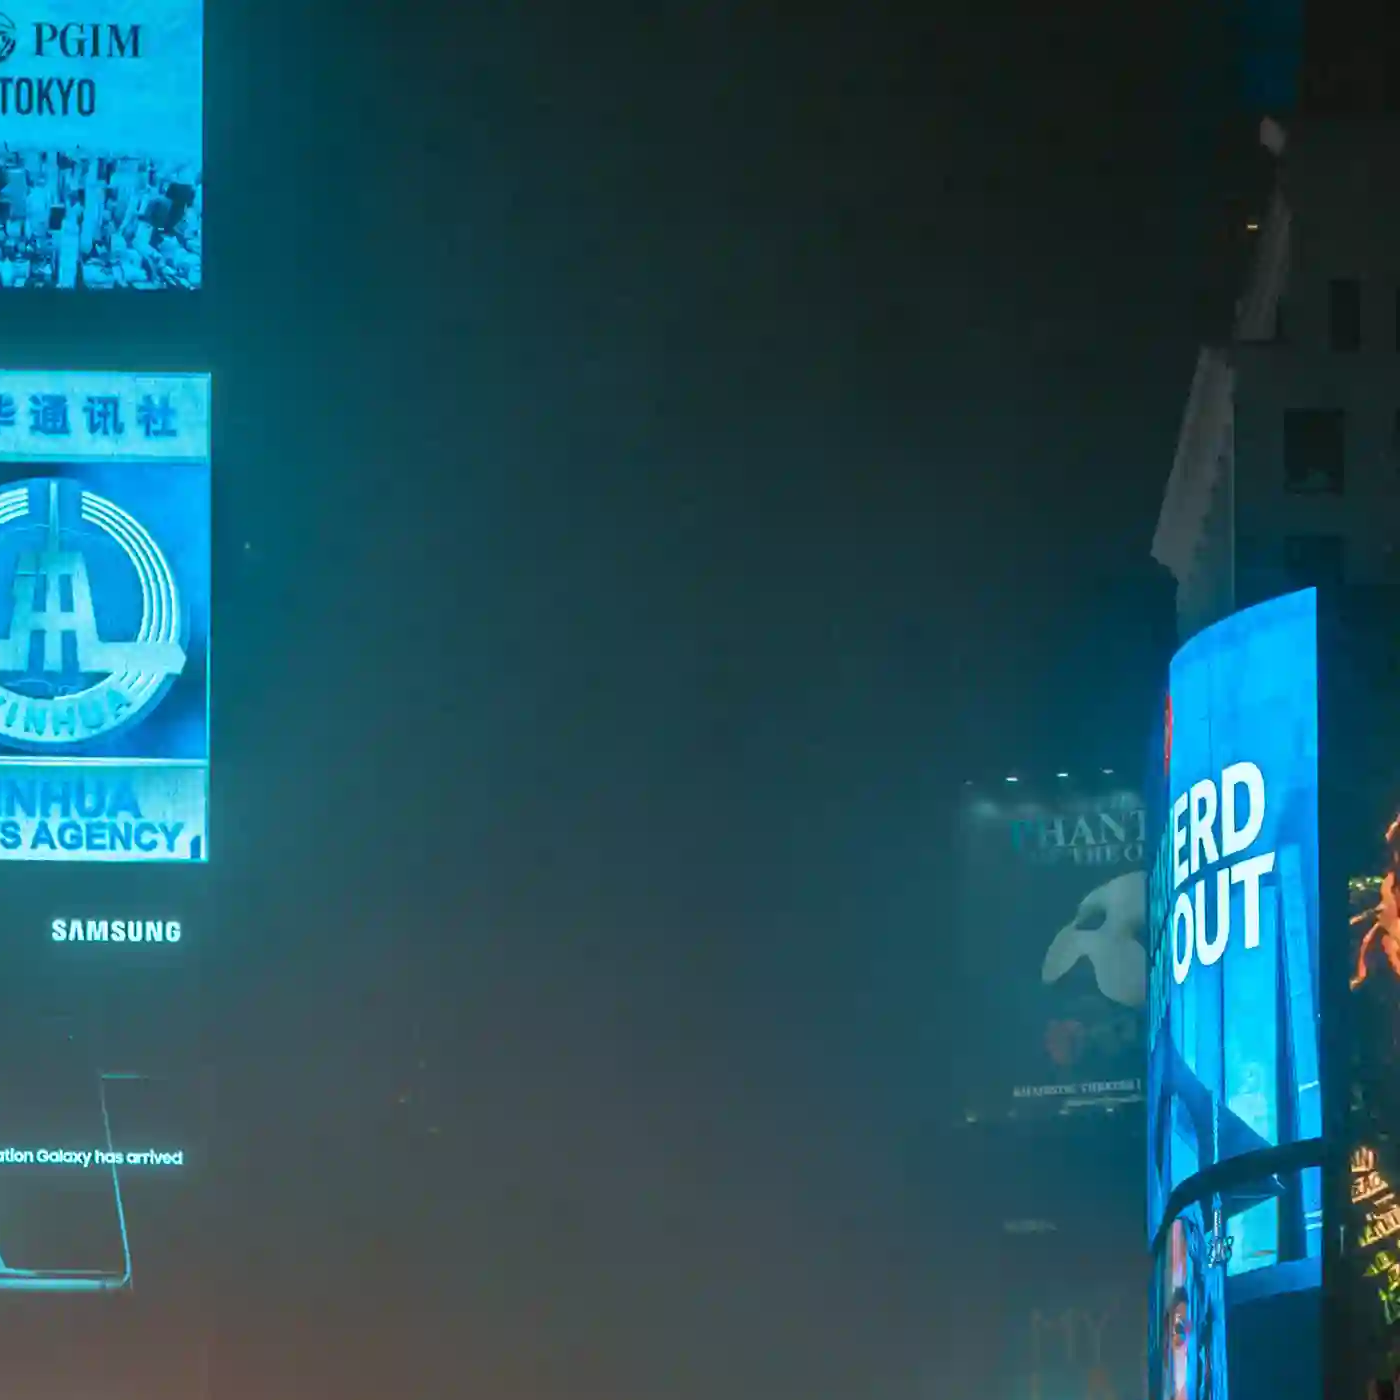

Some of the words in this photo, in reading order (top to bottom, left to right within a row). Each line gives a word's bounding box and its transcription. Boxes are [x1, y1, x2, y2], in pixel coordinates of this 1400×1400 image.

[34, 23, 141, 58] PGIM
[30, 821, 186, 852] AGENCY
[51, 919, 181, 943] SAMSUNG
[1172, 852, 1276, 985] OUT
[36, 1149, 91, 1168] Galaxy
[94, 1149, 124, 1165] has
[126, 1149, 183, 1166] arrived
